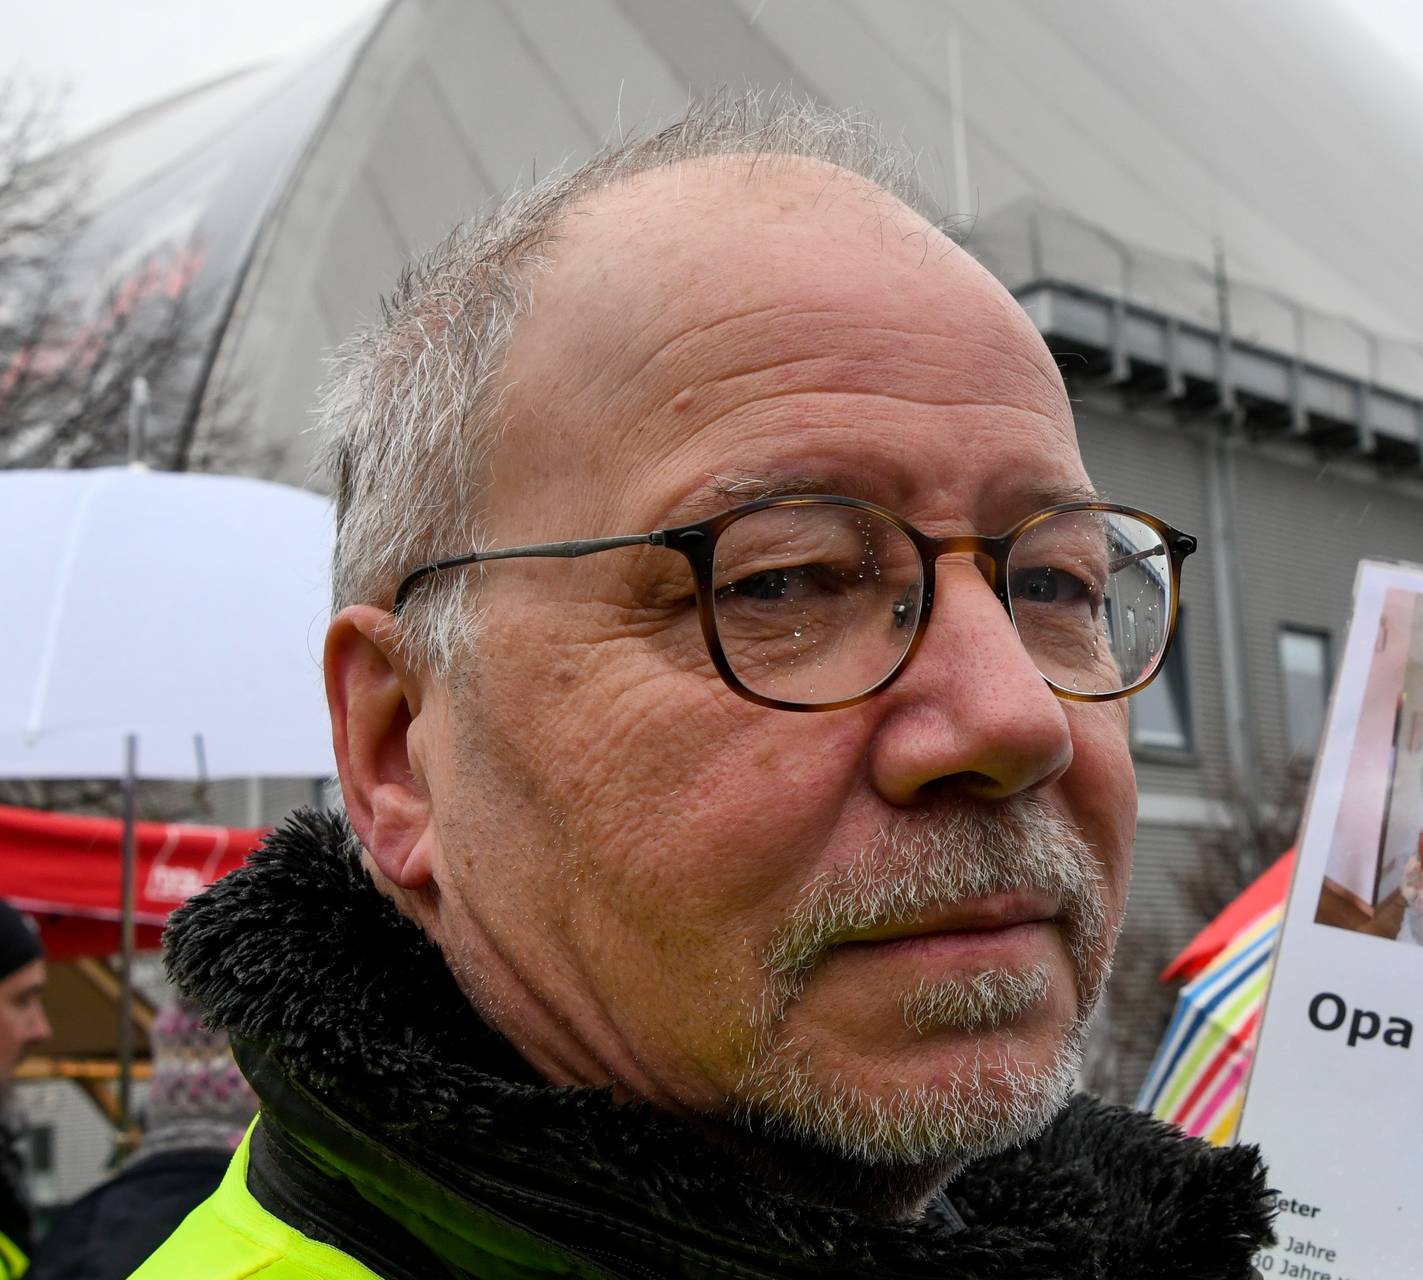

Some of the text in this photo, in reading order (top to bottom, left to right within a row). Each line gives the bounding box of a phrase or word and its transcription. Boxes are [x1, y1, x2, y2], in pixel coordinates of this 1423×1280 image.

[1307, 991, 1414, 1050] Opa
[1284, 1236, 1337, 1263] Jahre
[1279, 1259, 1332, 1280] Jahre
